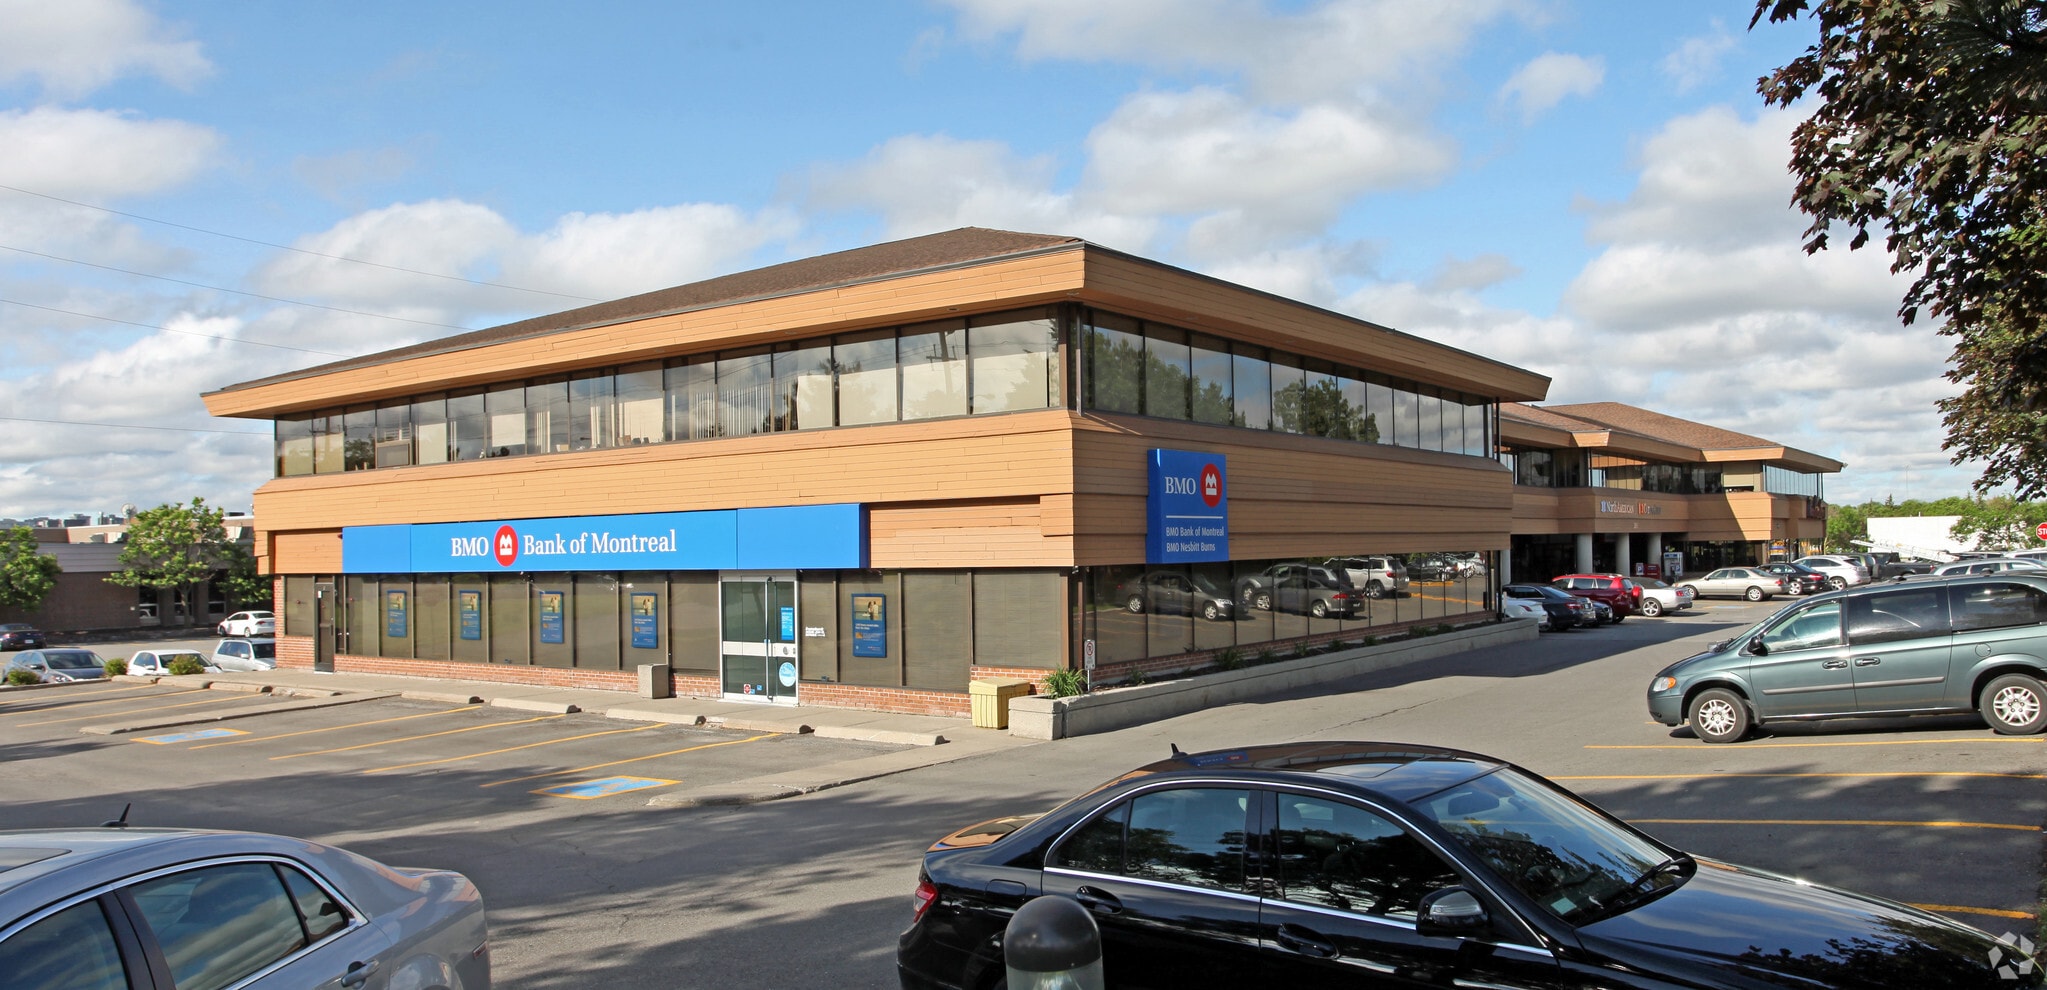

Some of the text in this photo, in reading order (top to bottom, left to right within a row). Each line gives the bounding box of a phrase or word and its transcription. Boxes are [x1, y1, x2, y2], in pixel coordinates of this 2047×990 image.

[1164, 476, 1196, 495] BMO
[1165, 526, 1225, 537] BMO Bank of Montreal
[451, 529, 677, 557] BMO Bank of Montreal
[1166, 541, 1216, 552] BMO Nesbitt Burns
